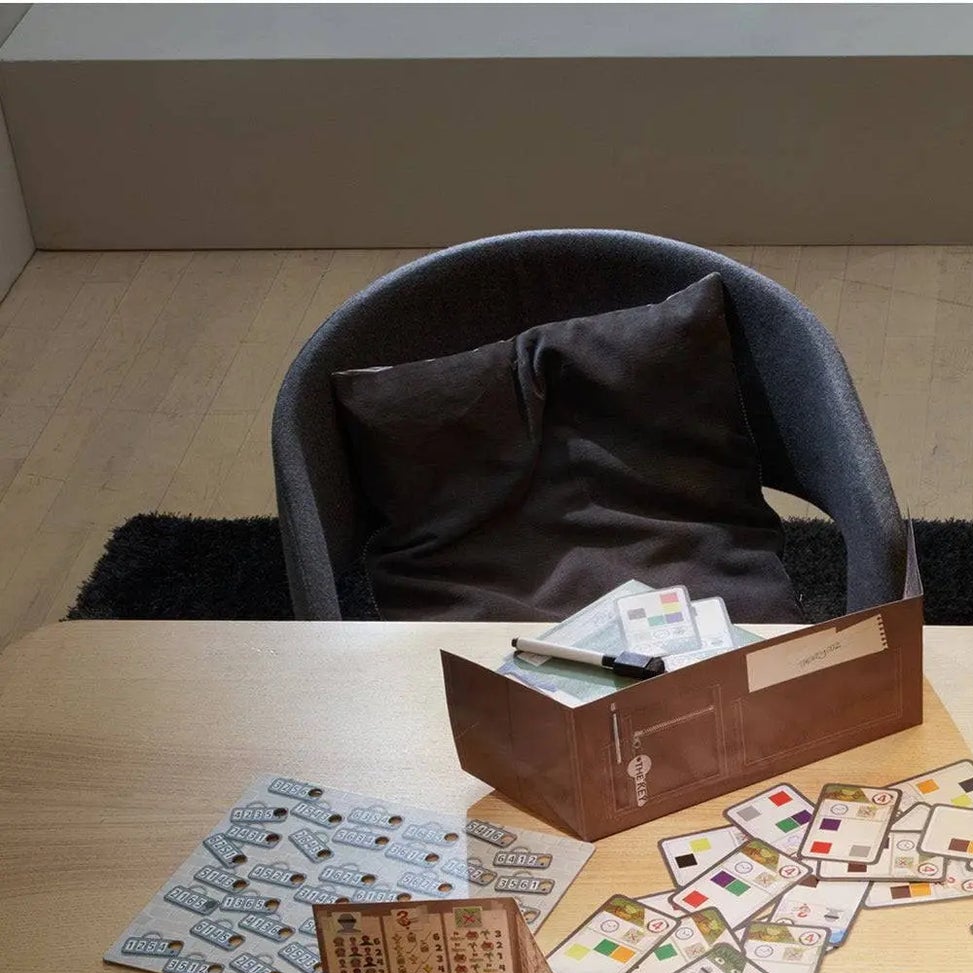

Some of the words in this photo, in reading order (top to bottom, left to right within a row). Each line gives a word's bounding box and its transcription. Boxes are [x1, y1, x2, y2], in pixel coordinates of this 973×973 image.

[635, 762, 644, 780] THE
[637, 782, 647, 800] KEY
[230, 826, 266, 841] 2431
[467, 822, 502, 840] 5416
[498, 854, 537, 864] 6412
[500, 879, 539, 890] 3561
[168, 961, 208, 973] 3512
